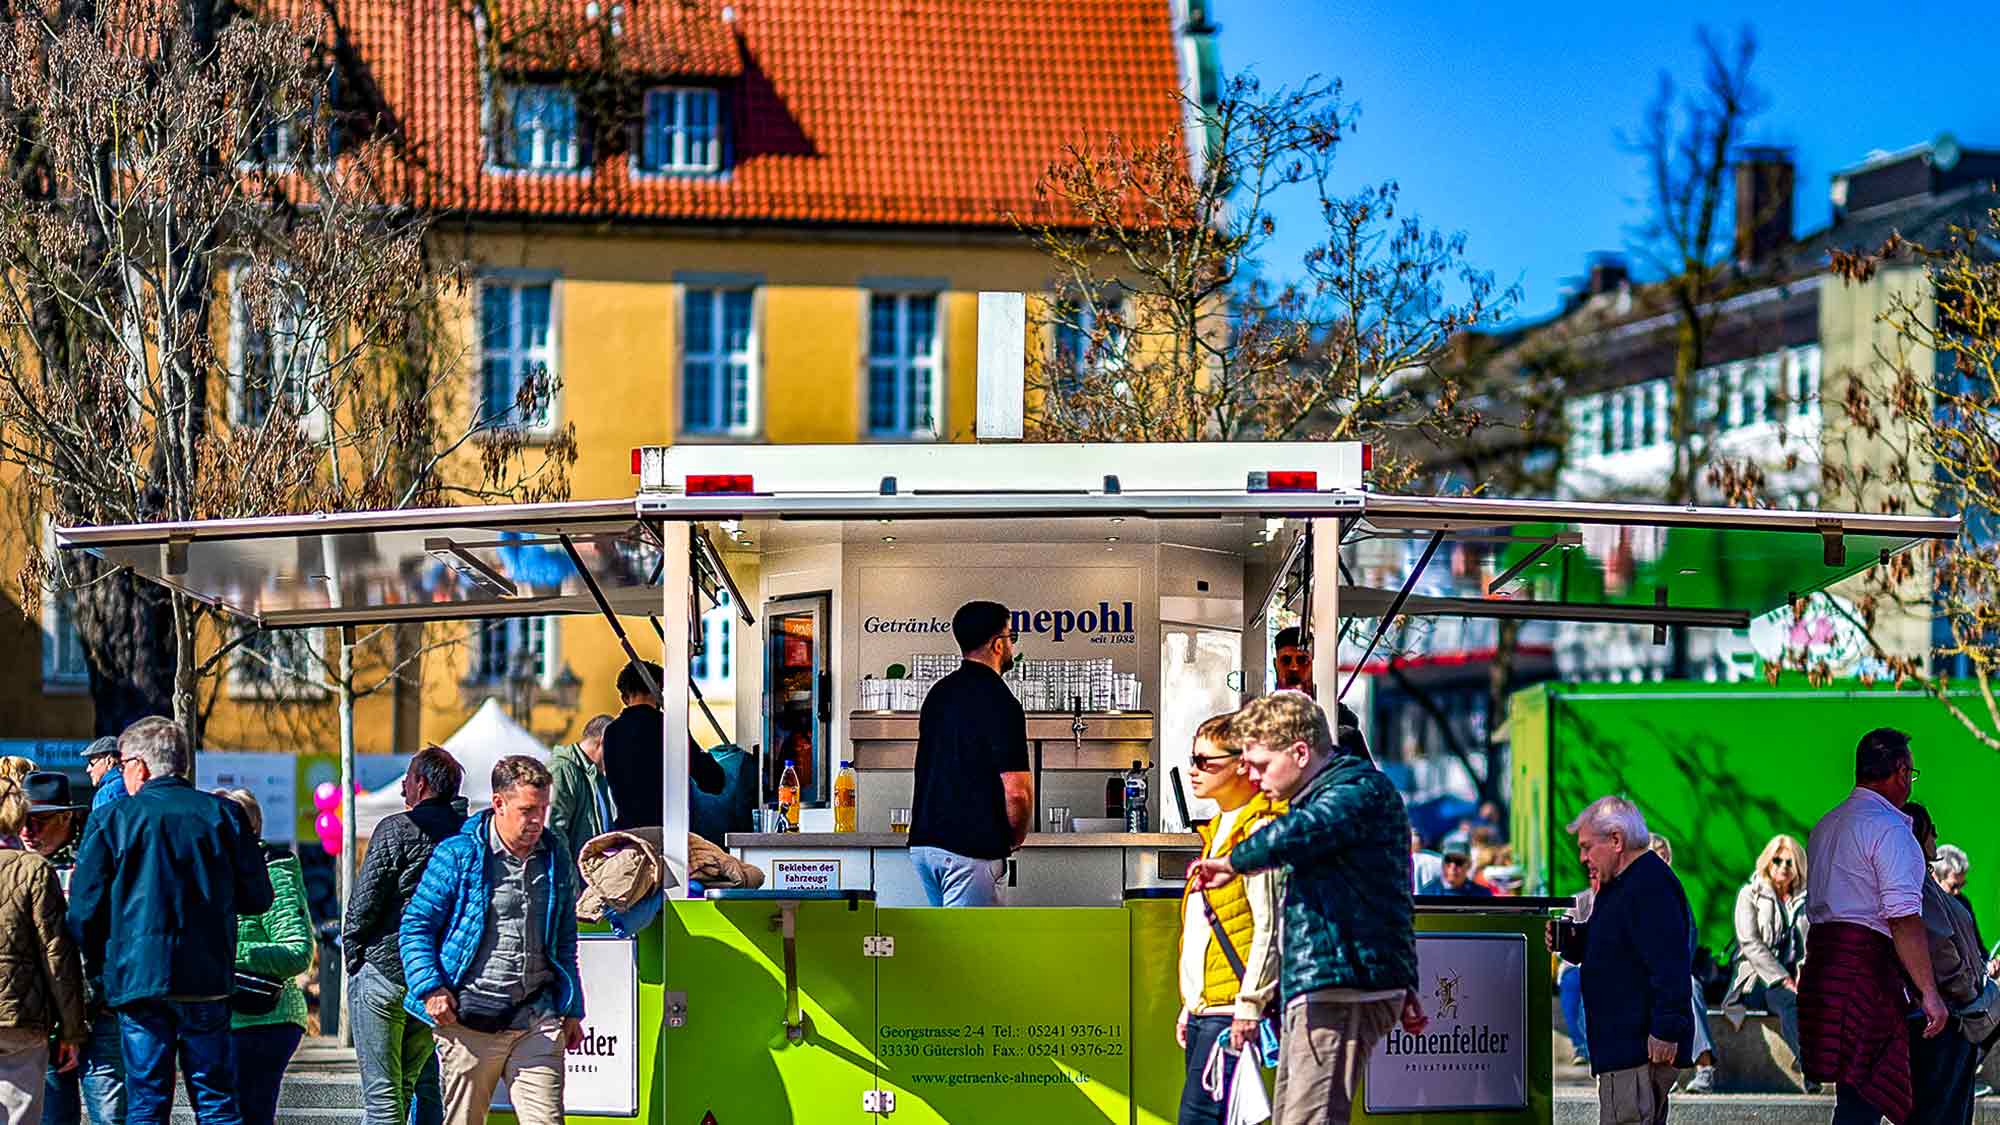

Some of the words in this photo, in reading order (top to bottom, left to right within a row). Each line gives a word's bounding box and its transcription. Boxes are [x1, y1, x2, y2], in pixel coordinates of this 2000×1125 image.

[864, 616, 951, 633] Getränke
[785, 875, 828, 884] Fahrzeugs
[880, 1026, 960, 1040] Georgstrasse
[964, 1025, 984, 1037] 2-4
[992, 1025, 1019, 1037] Tel.:
[1028, 1025, 1065, 1037] 05241
[1071, 1025, 1121, 1037] 9376-11
[880, 1044, 919, 1056] 33330
[923, 1044, 984, 1056] Gütersloh
[1028, 1044, 1065, 1056] 05241
[1071, 1044, 1123, 1056] 9376-22
[912, 1071, 1090, 1086] www.getraenke-ahnepohl.de
